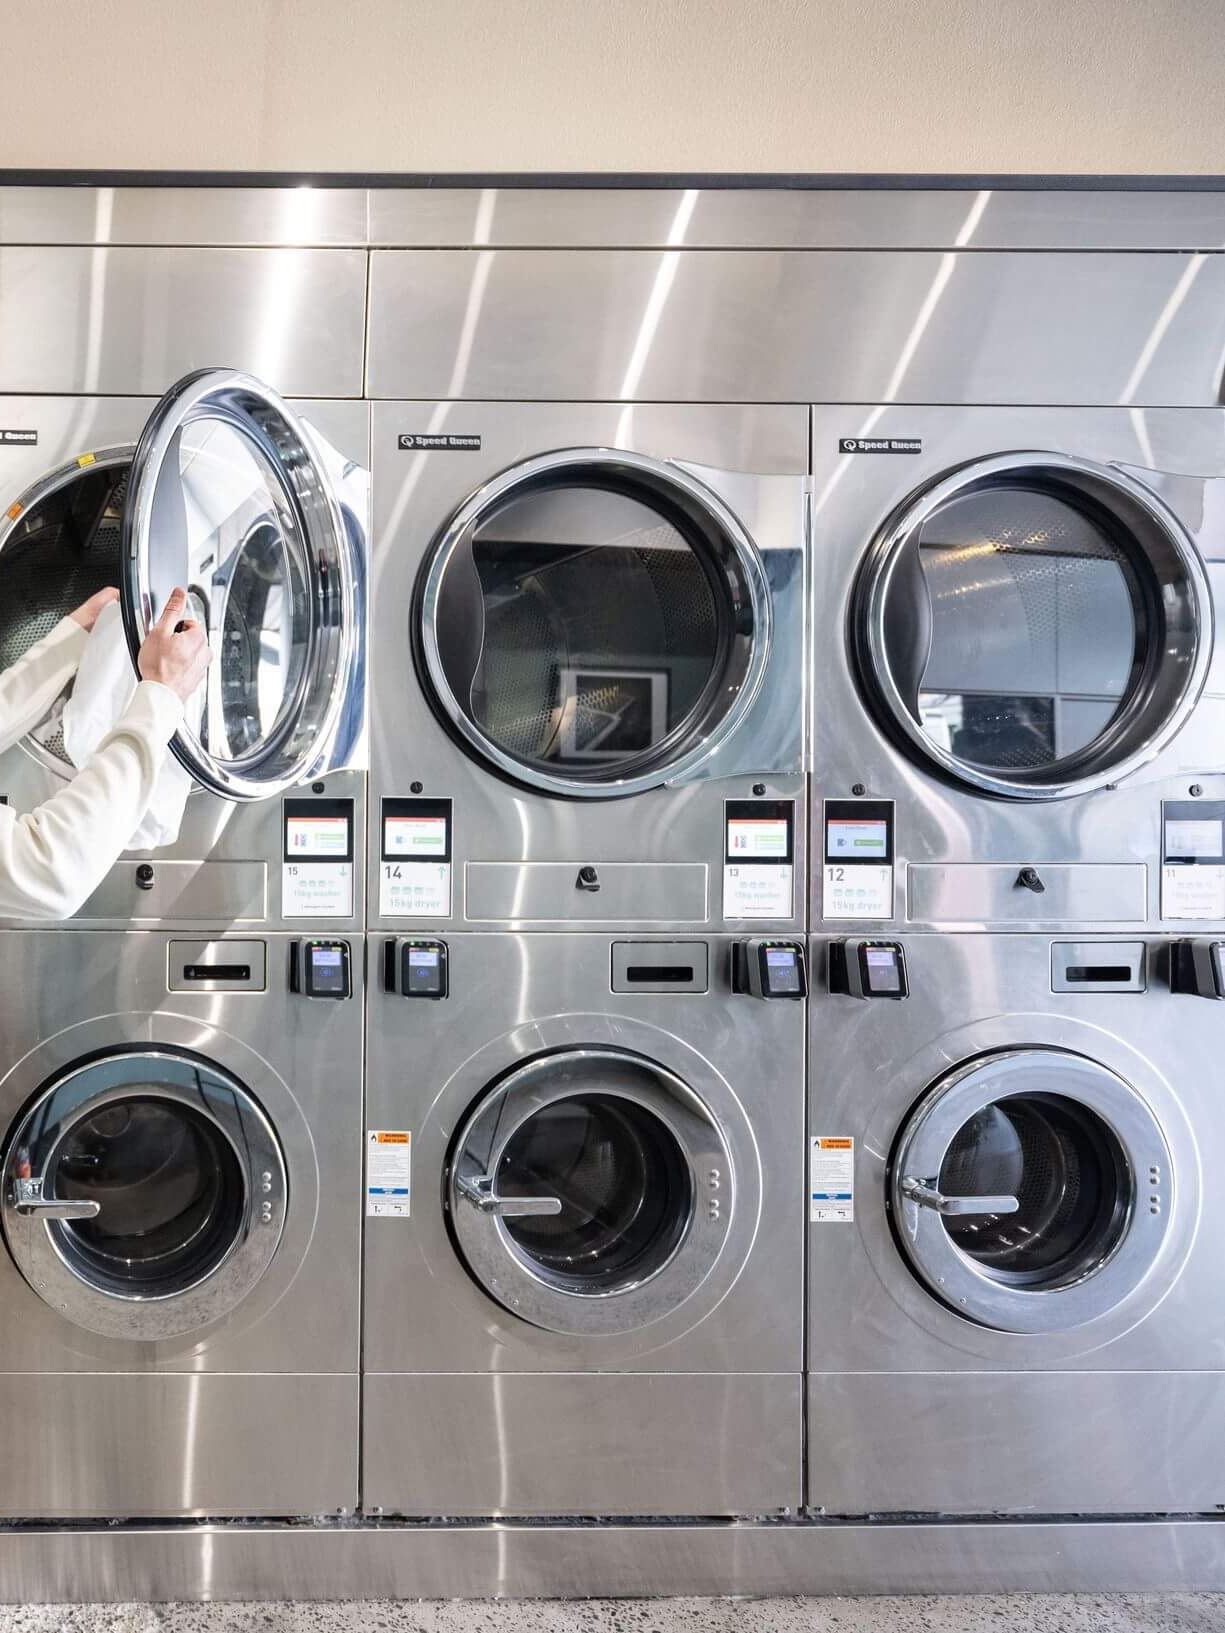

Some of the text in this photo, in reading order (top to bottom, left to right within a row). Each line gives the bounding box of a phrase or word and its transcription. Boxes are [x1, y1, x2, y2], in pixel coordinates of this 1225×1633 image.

[5, 432, 36, 440] Queen
[416, 436, 448, 446] Speed
[449, 437, 480, 445] Queen
[858, 440, 889, 450] Speed
[891, 441, 921, 449] Queen
[288, 866, 298, 876] 15
[384, 865, 402, 879] 14
[827, 868, 845, 882] 12
[415, 898, 441, 909] dryer
